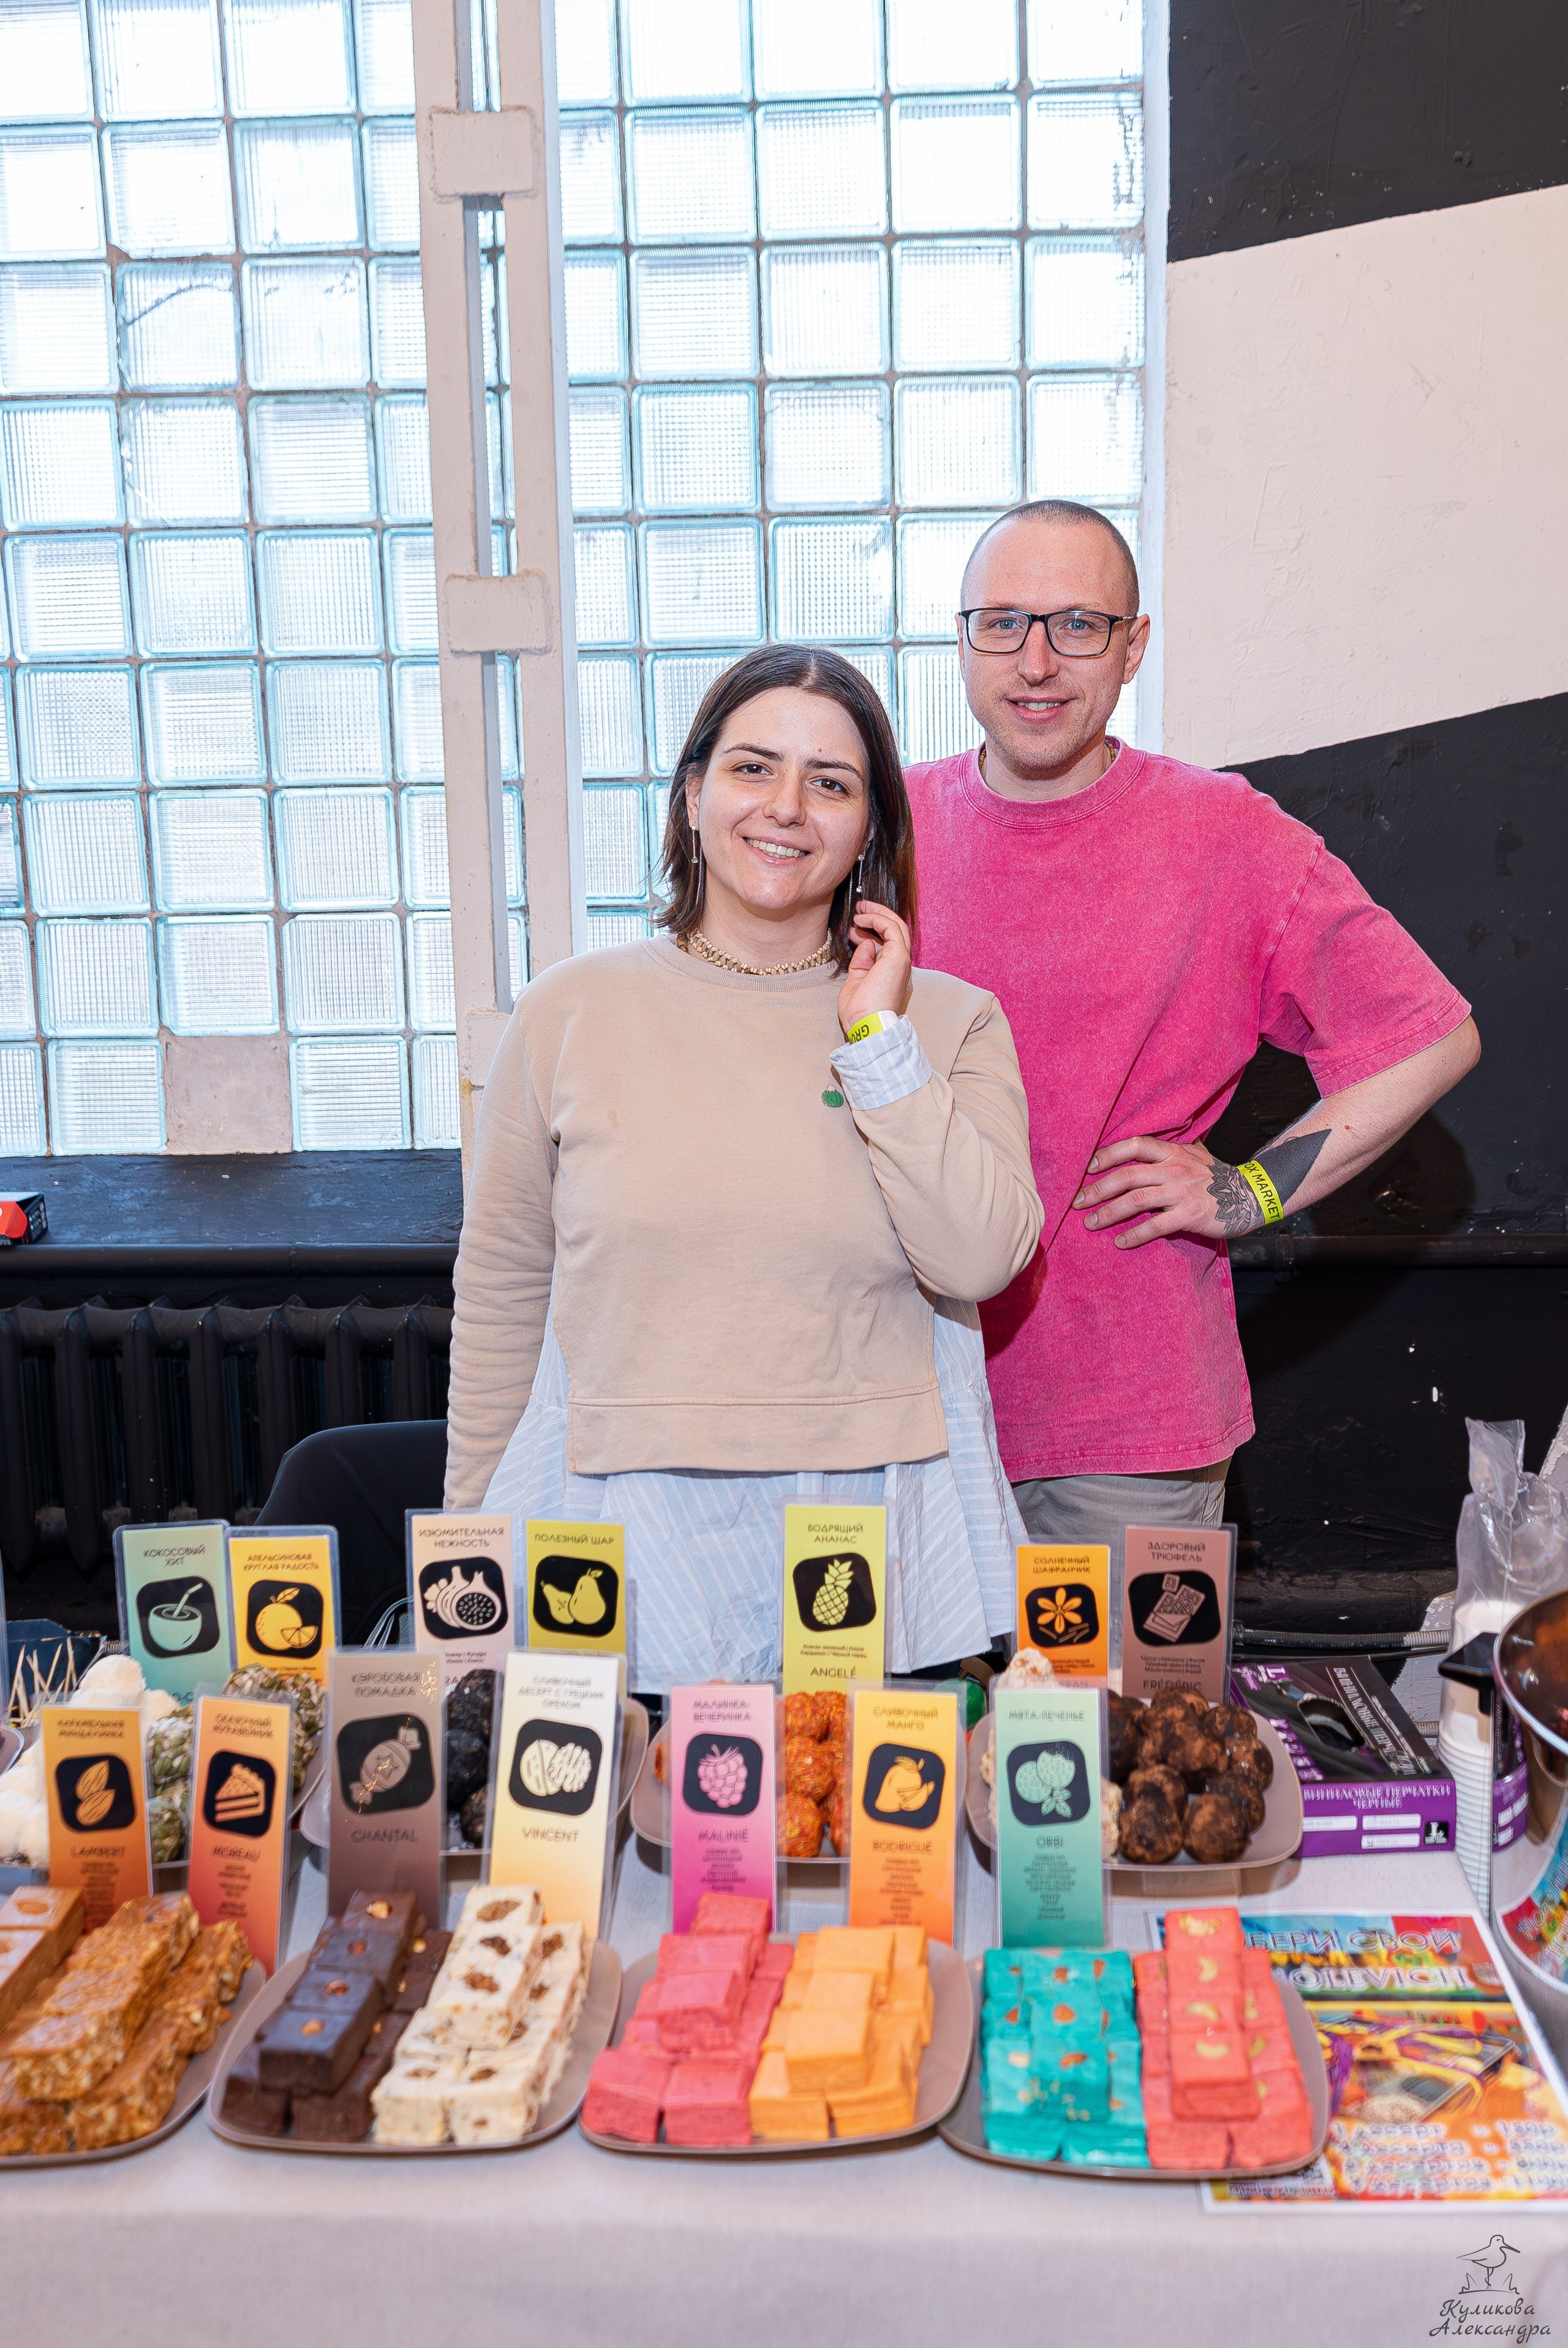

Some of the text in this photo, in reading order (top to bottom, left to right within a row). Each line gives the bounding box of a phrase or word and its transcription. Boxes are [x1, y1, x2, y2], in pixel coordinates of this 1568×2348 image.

[849, 1024, 869, 1045] GRO
[1252, 1174, 1280, 1219] MARKET
[808, 1523, 863, 1534] БОДРЯЩИЙ
[434, 1538, 490, 1549] НЕЖНОСТЬ
[535, 1531, 614, 1546] ПОЛЕЗНЫЙ ШАР
[814, 1535, 857, 1544] АНАНАС
[143, 1544, 206, 1558] КОКОСОВЫЙ
[1148, 1541, 1207, 1552] ЗДОРОВЫЙ
[164, 1557, 185, 1567] ХИТ
[1034, 1555, 1090, 1565] СОЛНЕЧНЫЙ
[1151, 1551, 1202, 1563] ТРЮФЕЛЬ
[352, 1672, 420, 1684] КЭРОБОВАЯ
[532, 1675, 592, 1686] СЛИВОЧНЫЙ
[355, 1686, 417, 1697] ПОМАДКА
[518, 1686, 552, 1697] ДЕСЕРТ
[542, 1698, 581, 1710] ОРЕХОМ
[873, 1706, 939, 1719] СЛИВОЧНЫЙ
[886, 1720, 925, 1731] МАНГО
[1385, 1784, 1450, 1798] ПЕРЧАТКИ
[350, 1827, 418, 1843] CHANTAL
[521, 1826, 580, 1843] VINCENT
[1246, 1927, 1462, 1954] БЕРИ СВОЙ
[1273, 1965, 1475, 1991] OLEVICH
